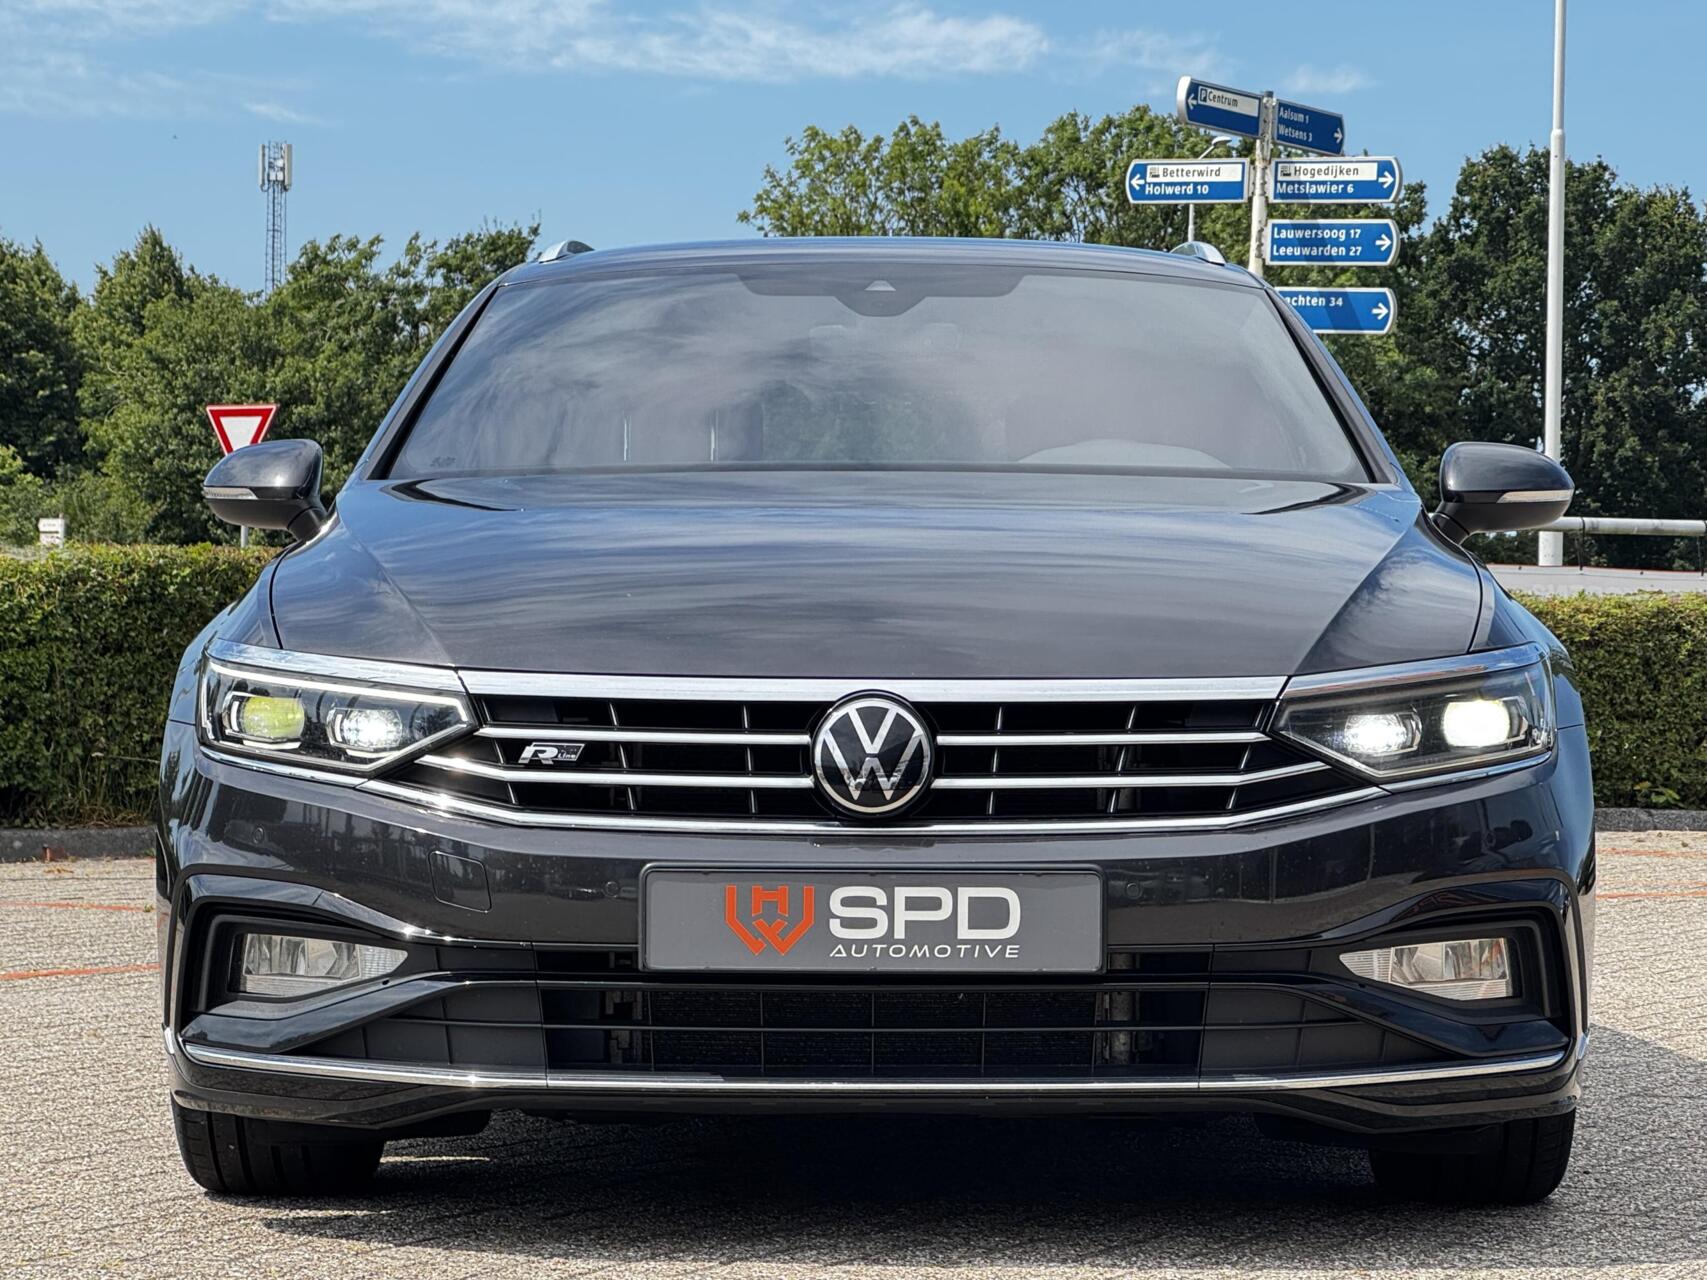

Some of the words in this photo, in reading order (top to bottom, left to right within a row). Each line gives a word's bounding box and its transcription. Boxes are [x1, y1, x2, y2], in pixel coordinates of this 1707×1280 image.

[1208, 90, 1238, 107] Centrum
[1279, 106, 1305, 122] Aalsum
[1305, 115, 1309, 124] 1
[1278, 124, 1307, 141] Wetsens
[1308, 132, 1313, 142] 3
[1162, 167, 1221, 177] Betterwird
[1294, 166, 1359, 178] Hogedijken
[1145, 184, 1194, 194] Holwerd
[1196, 185, 1209, 194] 10
[1276, 182, 1344, 193] Metslawier
[1347, 184, 1354, 194] 6
[1274, 227, 1346, 241] Lauwersoog
[1350, 229, 1361, 238] 17
[1273, 245, 1346, 256] Leeuwarden
[1349, 247, 1362, 256] 27
[1329, 297, 1343, 307] 34
[829, 886, 1021, 940] SPD
[829, 944, 1020, 958] AUTOMOTIVE
